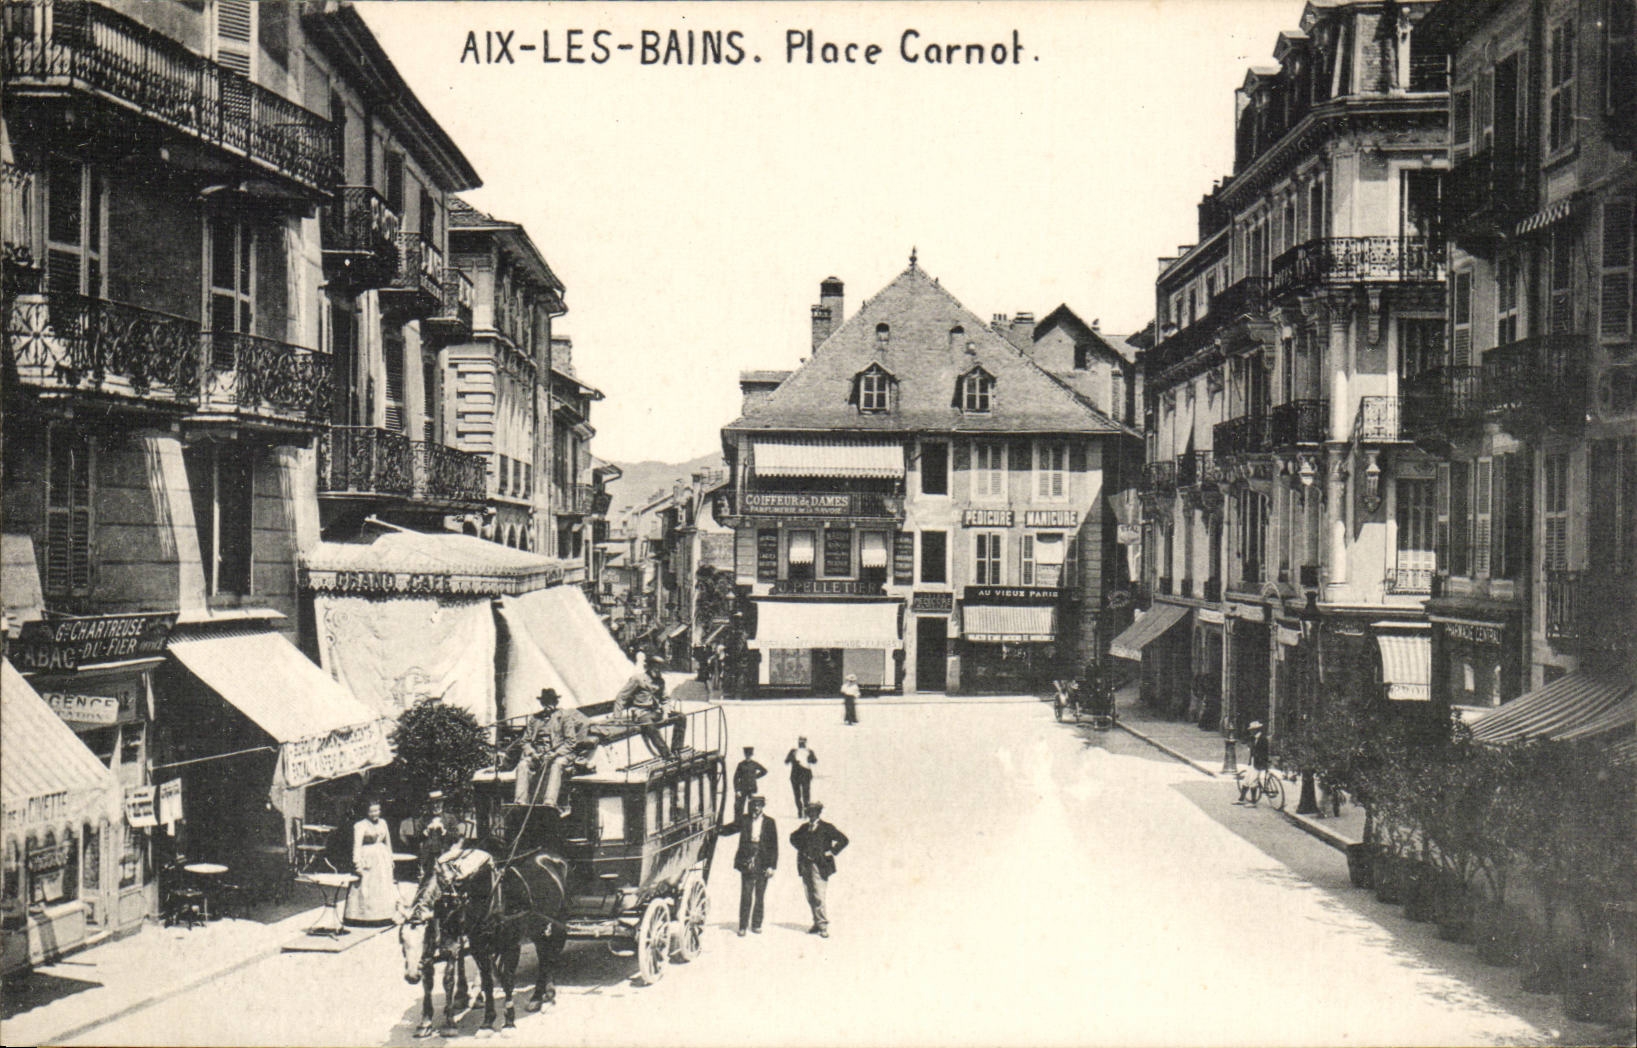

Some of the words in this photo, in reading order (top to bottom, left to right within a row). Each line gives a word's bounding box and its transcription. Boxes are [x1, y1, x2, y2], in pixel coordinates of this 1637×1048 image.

[745, 494, 800, 507] COIFFEUR
[811, 494, 849, 507] DAMES
[965, 511, 1013, 526] PEDICURE
[1026, 511, 1077, 527] MANICURE
[336, 571, 397, 592] GRAND
[793, 581, 877, 593] PELLETIER
[1029, 590, 1059, 598] PARIS
[71, 618, 146, 641] CHARTREUSE
[21, 648, 75, 669] ABAC
[50, 693, 115, 709] GENCE
